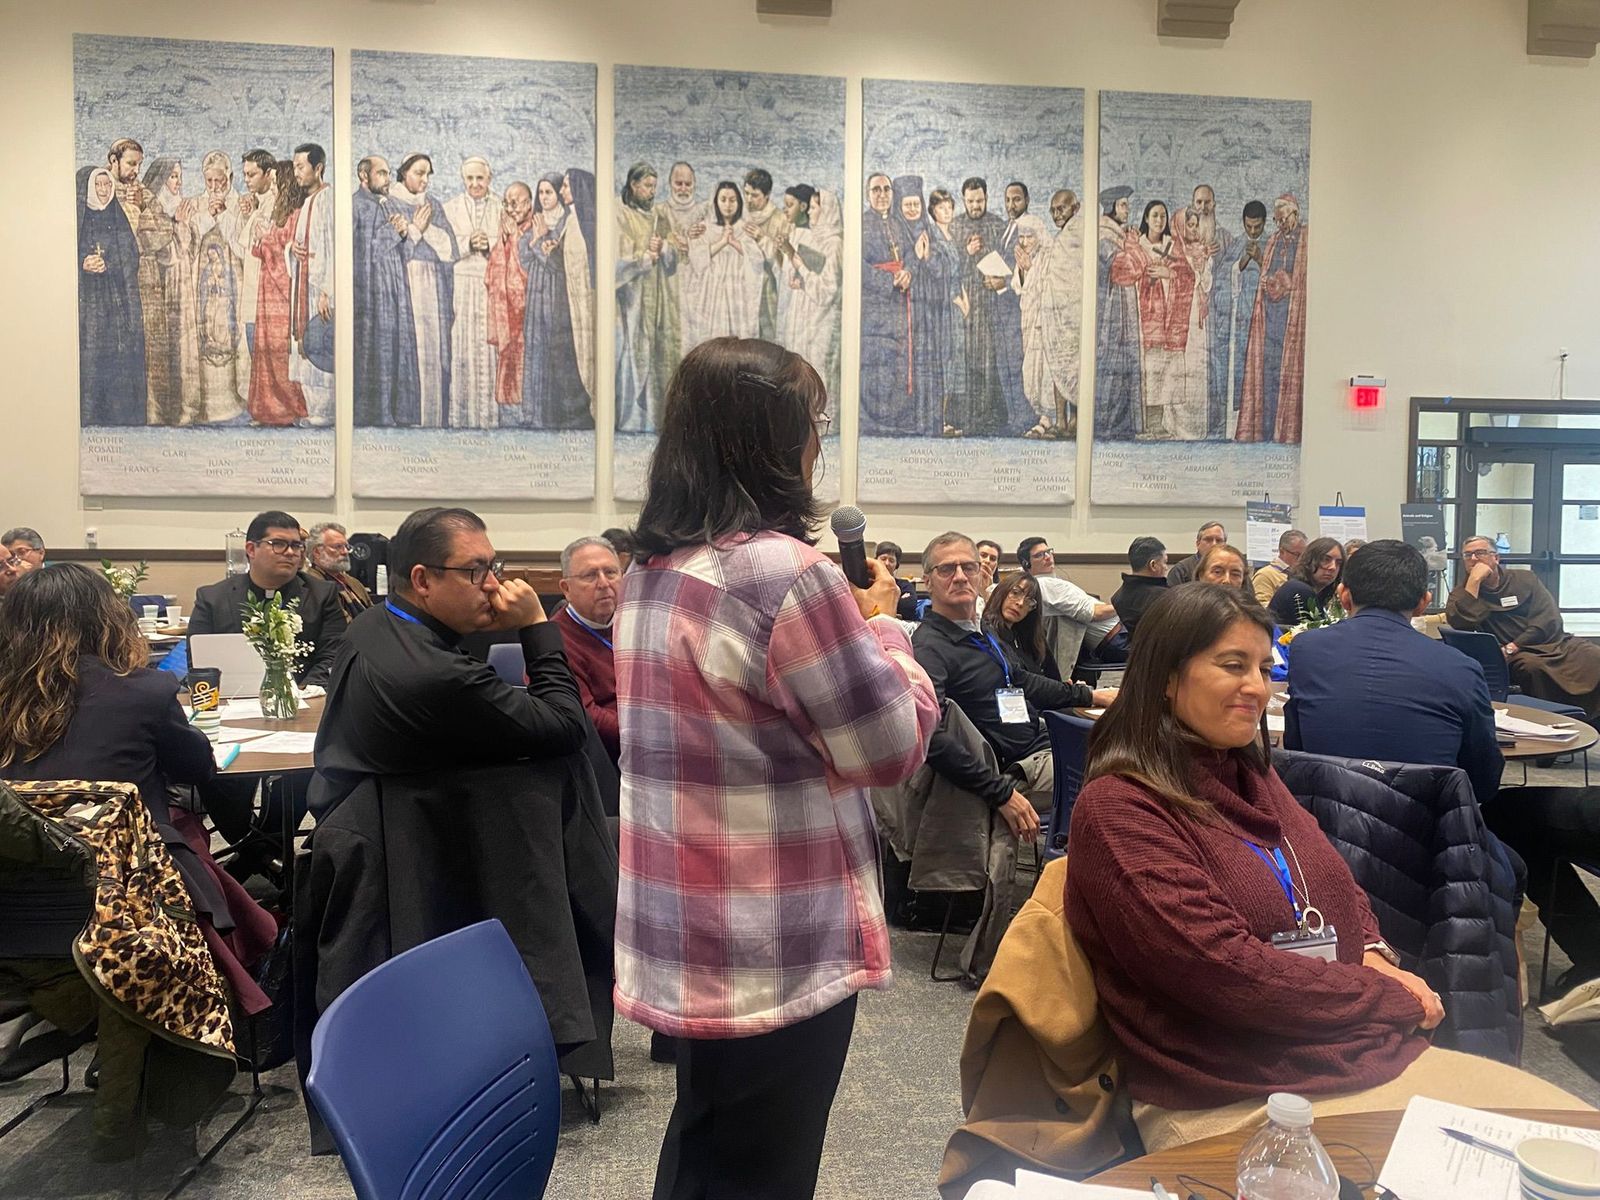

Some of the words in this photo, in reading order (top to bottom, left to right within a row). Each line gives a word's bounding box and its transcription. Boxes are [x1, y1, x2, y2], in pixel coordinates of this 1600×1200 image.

[87, 436, 124, 445] MOTHER
[235, 439, 276, 448] LORENZO
[295, 439, 331, 447] ANDREW
[362, 443, 401, 452] IGNATIUS
[162, 450, 187, 458] CLARE
[245, 449, 265, 457] RUIZ
[305, 448, 321, 456] KIM
[956, 449, 986, 457] DAMIEN
[1020, 449, 1052, 457] MOTHER
[1098, 452, 1129, 460] THOMAS
[96, 455, 114, 463] HILL
[402, 456, 438, 465] THOMAS
[504, 454, 526, 462] LAMA
[1169, 454, 1193, 462] SARAH
[208, 459, 231, 467] JUAN
[1102, 460, 1123, 468] MORE
[124, 465, 160, 473] FRANCIS
[206, 468, 234, 477] DIEGO
[271, 467, 296, 475] MARY
[401, 466, 439, 474] AQUINAS
[868, 468, 894, 476] OSCAR
[993, 467, 1022, 475] MARTIN
[1184, 464, 1219, 473] ABRAHAM
[933, 470, 970, 478] DOROTHY
[1142, 474, 1167, 482] KATERI
[257, 477, 308, 485] MAGDALENE
[864, 477, 897, 485] ROMERO
[993, 476, 1021, 484] LUTHER
[1032, 475, 1071, 484] MAHATMA
[1036, 484, 1067, 492] GANDHI
[1237, 480, 1265, 488] MARTIN
